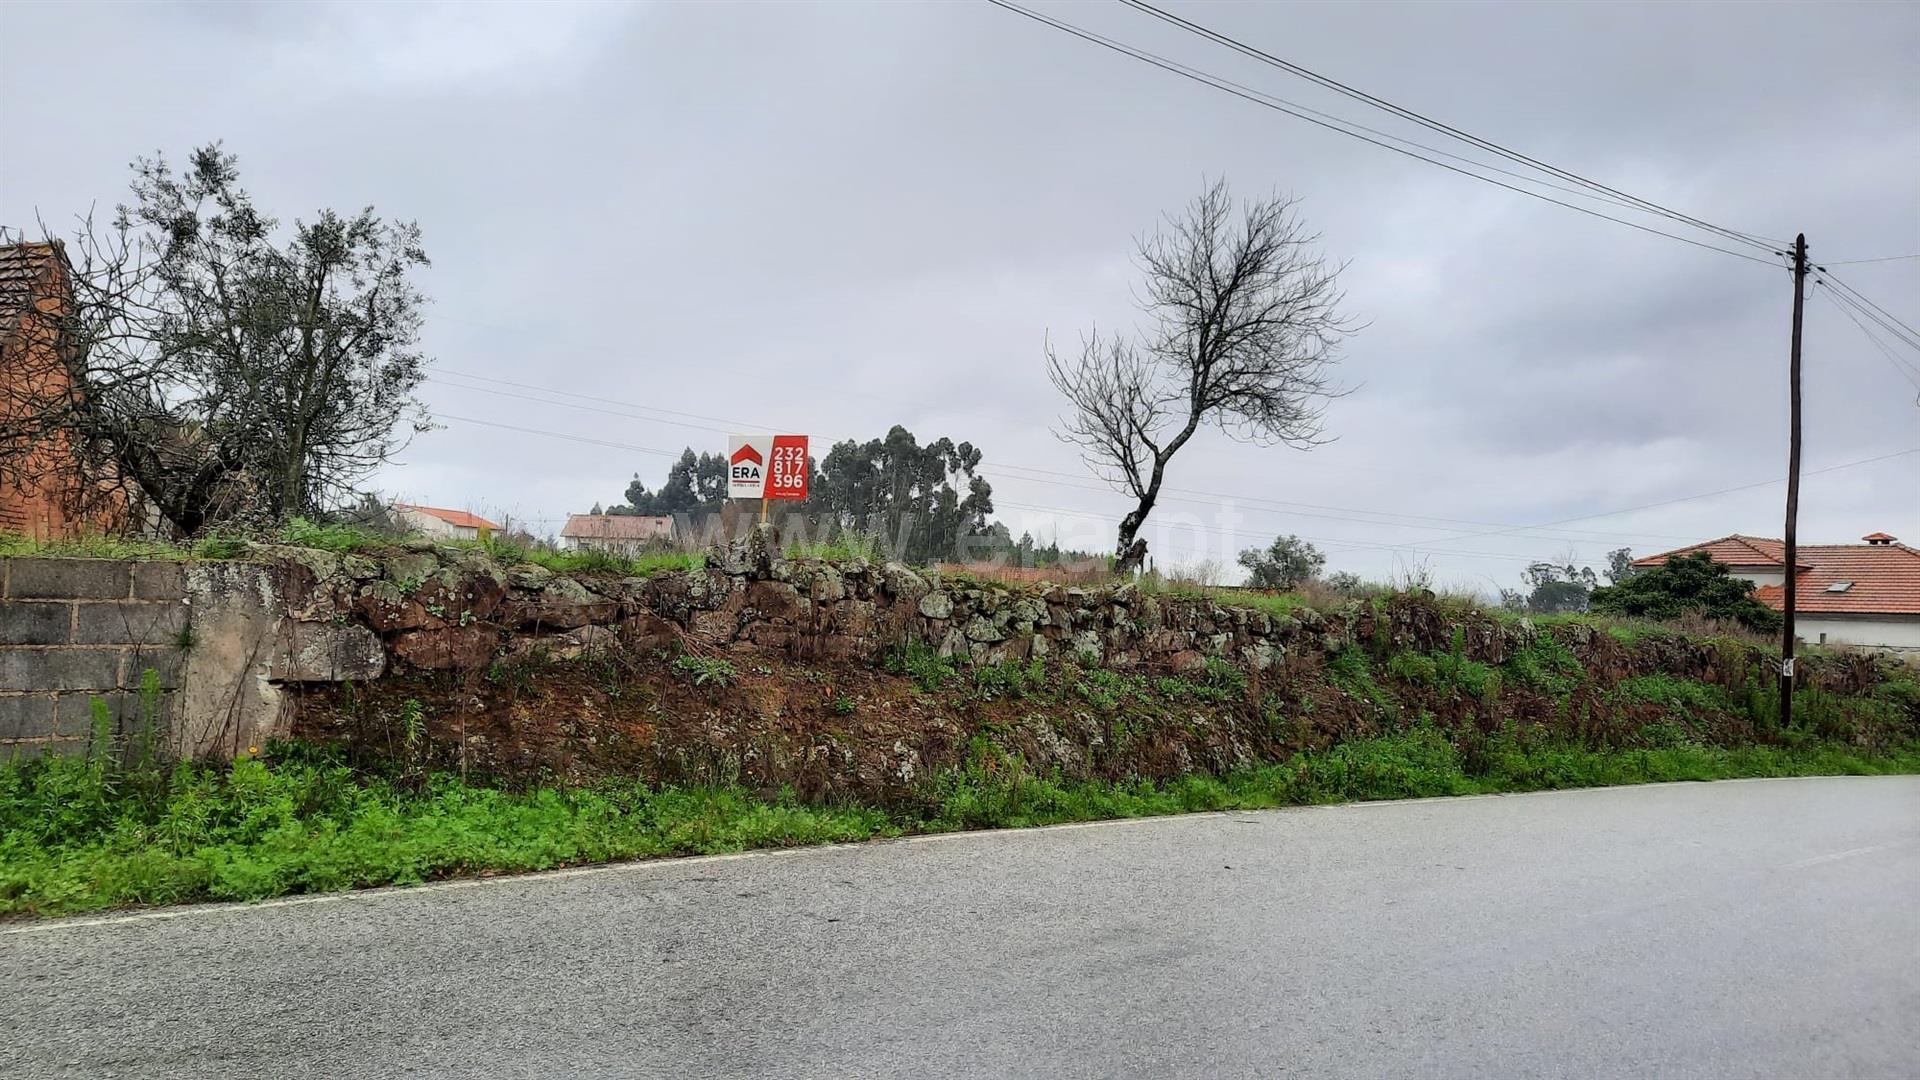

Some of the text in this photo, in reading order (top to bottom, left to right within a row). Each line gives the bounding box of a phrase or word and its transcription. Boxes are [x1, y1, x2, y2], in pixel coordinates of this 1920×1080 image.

[774, 447, 804, 461] 232
[732, 467, 760, 479] ERA
[773, 461, 804, 475] 817
[773, 474, 804, 488] 396
